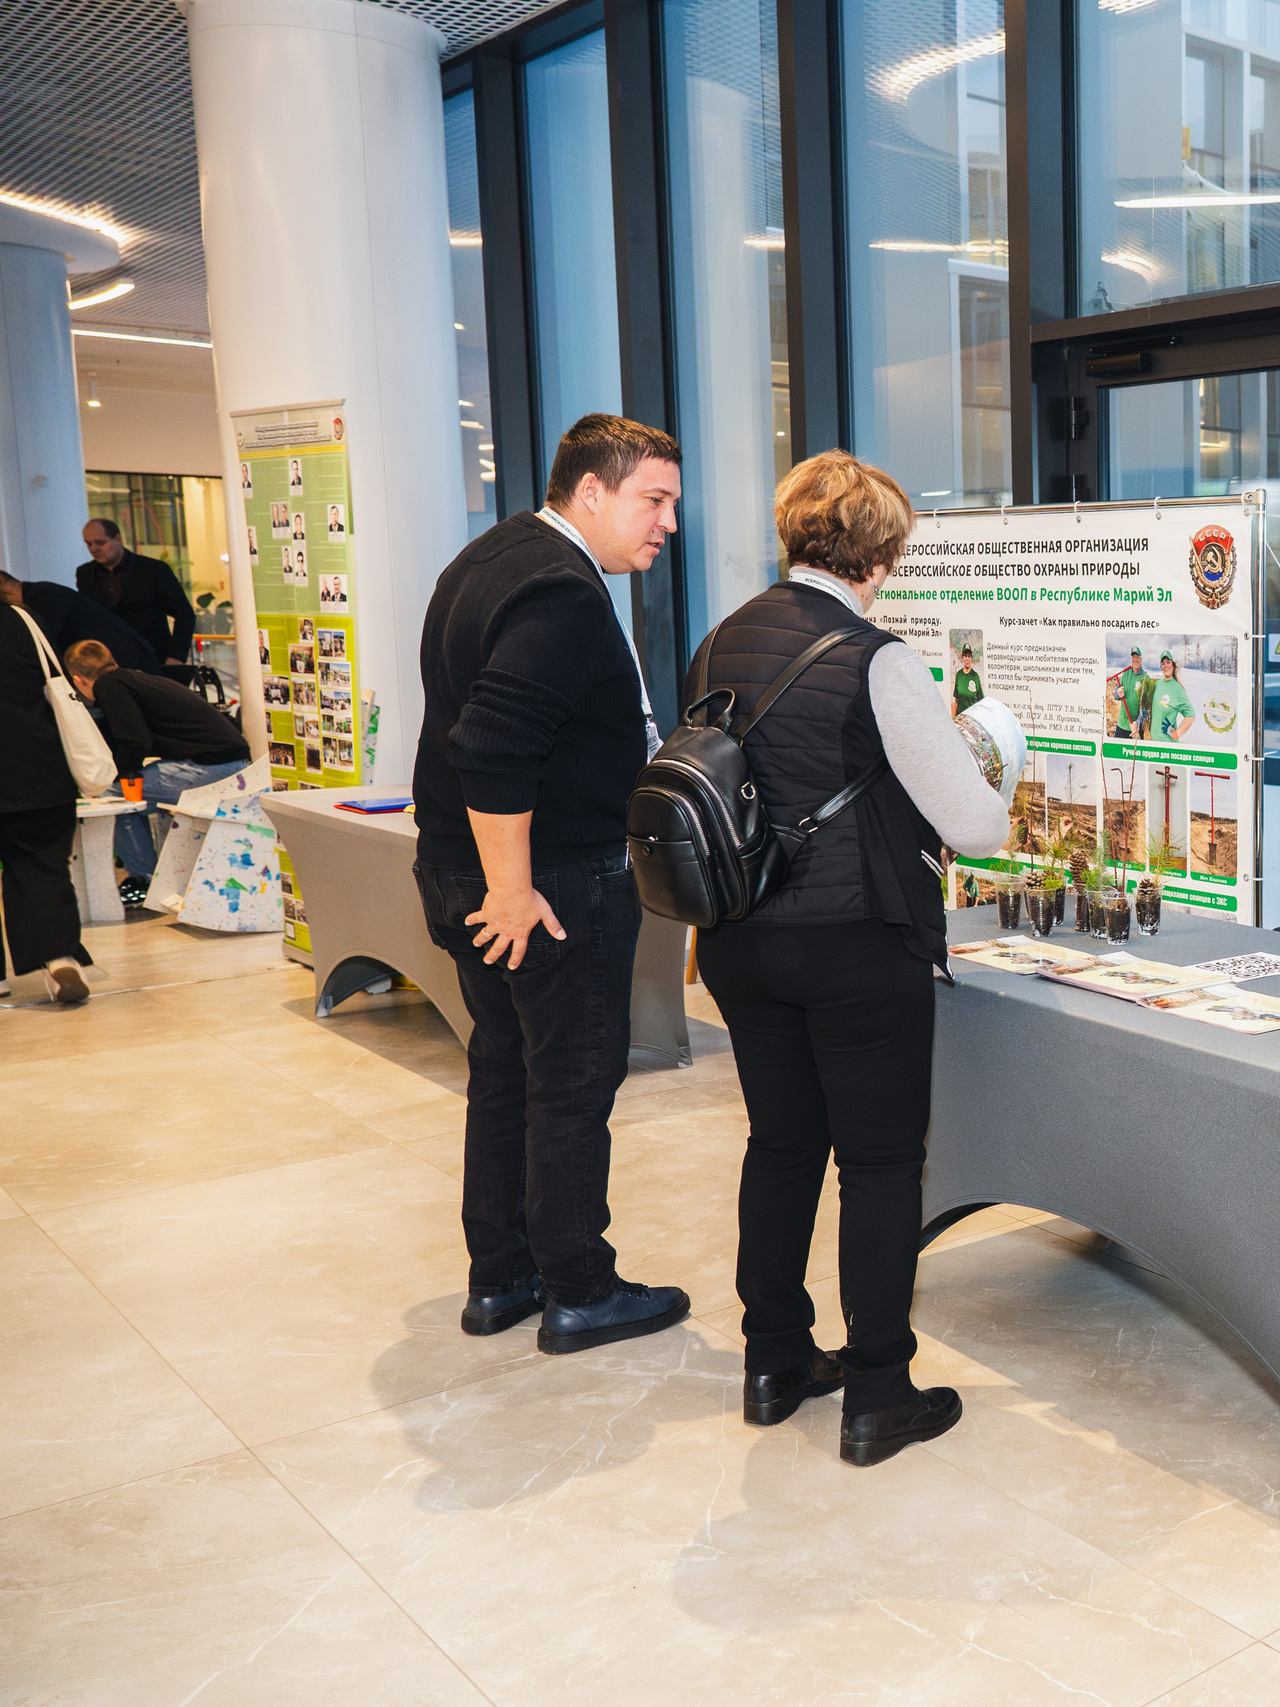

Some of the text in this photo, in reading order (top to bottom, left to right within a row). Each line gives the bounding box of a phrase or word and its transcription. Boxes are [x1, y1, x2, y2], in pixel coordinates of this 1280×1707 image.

[1198, 528, 1227, 542] СССР
[901, 538, 1148, 559] ЕРОССИЙСКАЯ ОБЩЕСТВЕННАЯ ОРГАНИЗАЦИЯ
[974, 564, 1031, 579] ОБЩЕСТВО
[1034, 563, 1078, 576] ОХРАНЫ
[1082, 562, 1140, 579] ПРИРОДЫ
[874, 587, 1172, 605] егиональное отделение ВООП в Республике Марий Эл
[879, 614, 942, 626] «Познай природу.
[999, 616, 1159, 630] Курс-зачет «Как правильно посадить лес»
[909, 628, 942, 638] Марий Эл»
[986, 642, 1066, 653] Данный курс предназначен
[987, 654, 1099, 665] неравнодушным любителям природы,
[988, 663, 1022, 672] волонтёрам,
[1023, 665, 1060, 673] школьникам
[1014, 672, 1022, 681] бы
[1023, 675, 1055, 683] принимать
[1056, 677, 1080, 685] участие
[992, 683, 1015, 691] посадке
[1142, 750, 1160, 759] орудия
[1170, 753, 1192, 761] посадки
[1192, 755, 1215, 763] сеянцев
